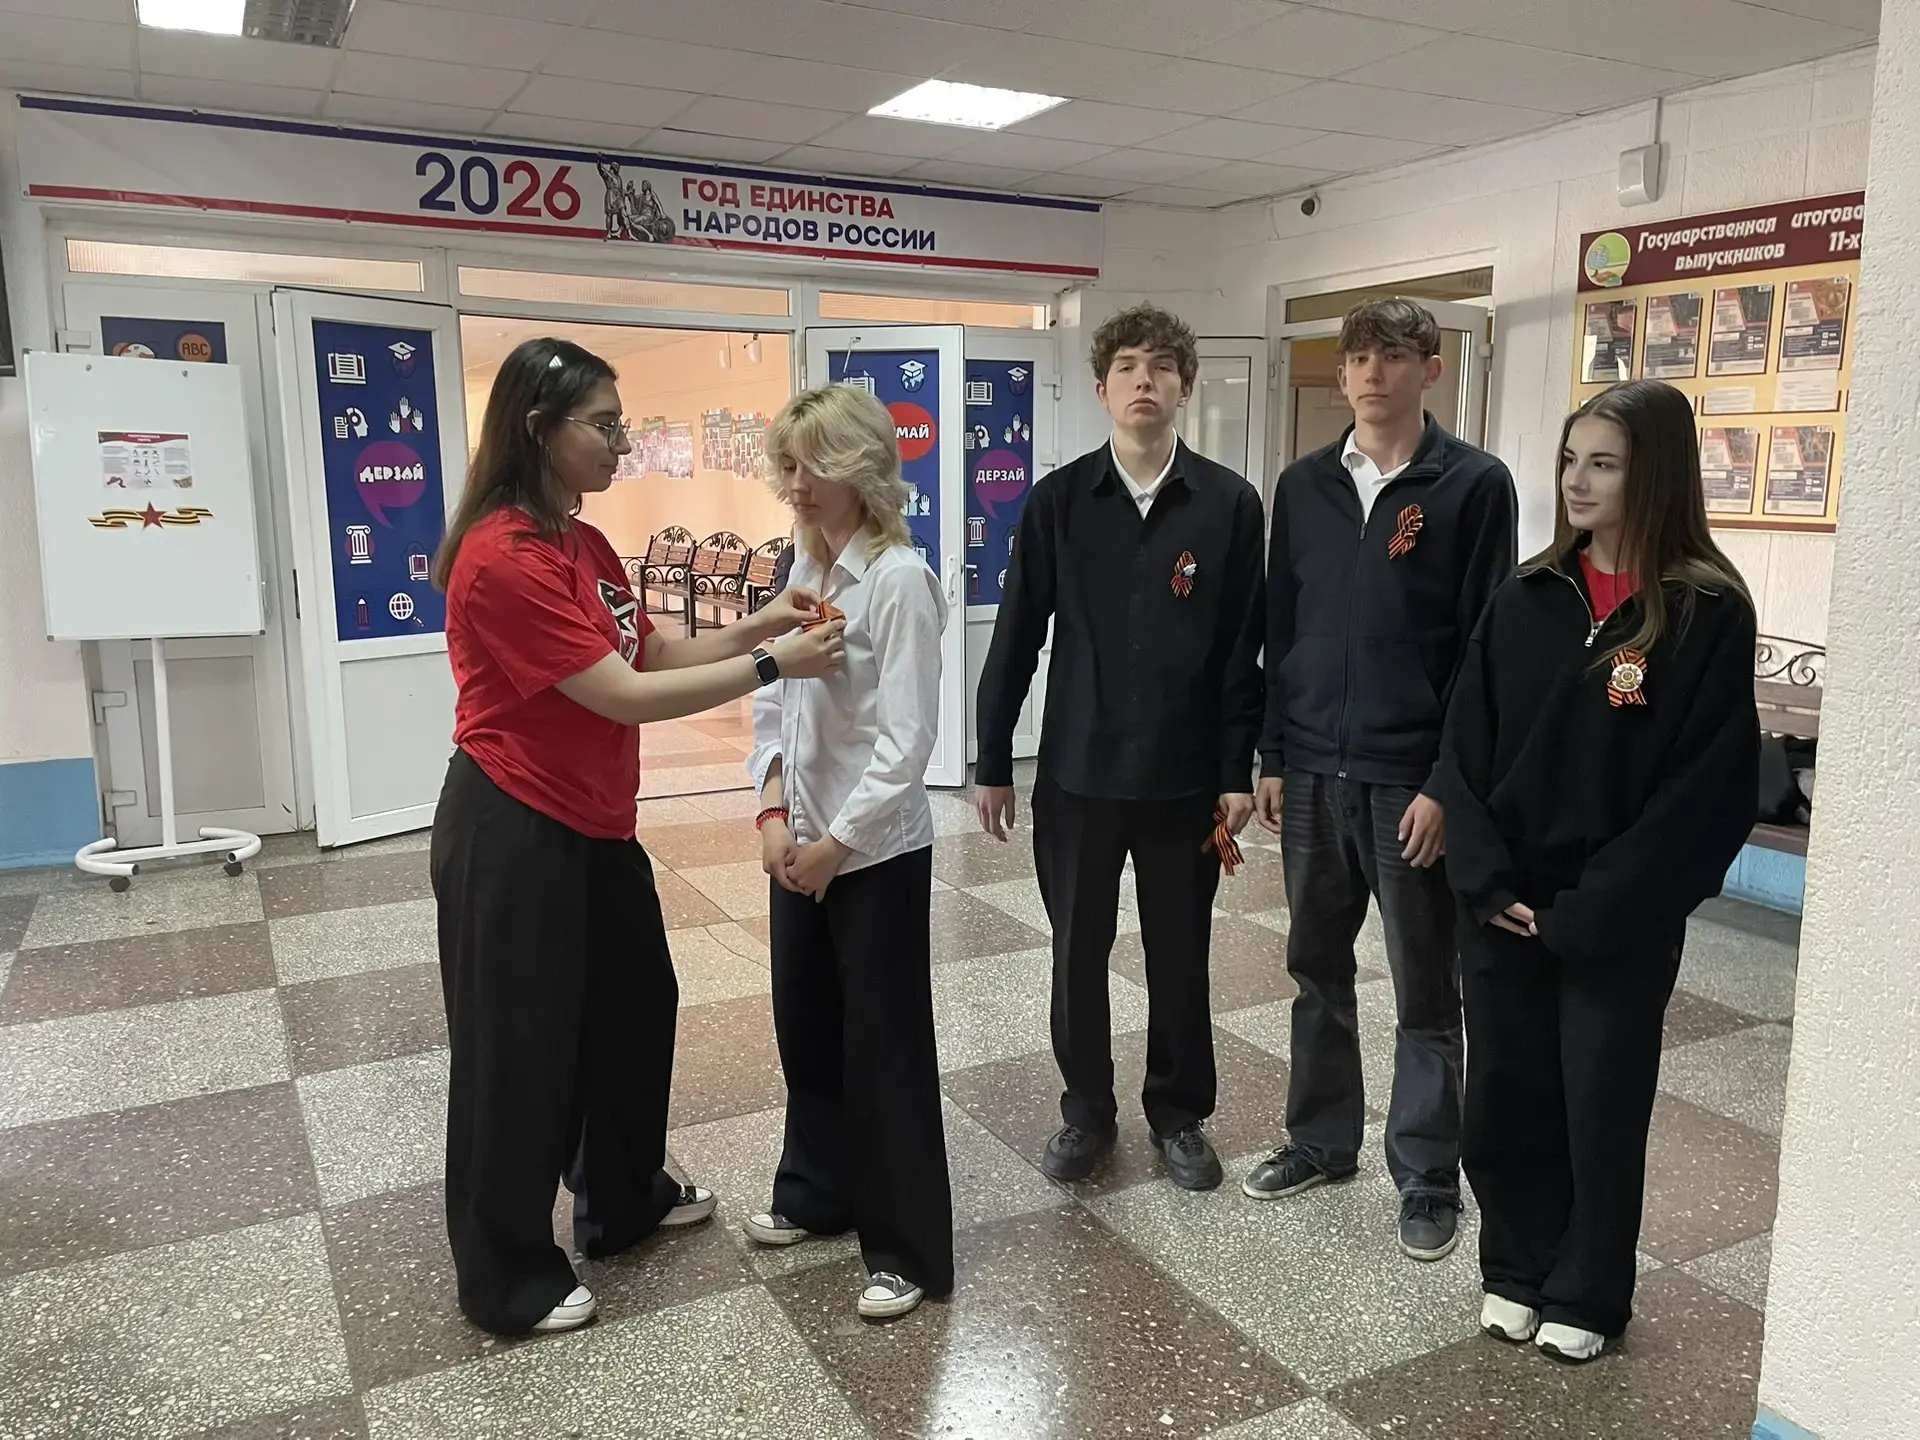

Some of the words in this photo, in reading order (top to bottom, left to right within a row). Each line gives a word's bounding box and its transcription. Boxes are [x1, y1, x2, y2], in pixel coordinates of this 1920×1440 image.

[416, 152, 581, 221] 2026
[681, 177, 740, 209] ГОД
[750, 185, 895, 219] ЕДИНСТВА
[683, 208, 819, 242] НАРОДОВ
[828, 222, 935, 251] РОССИИ
[1638, 216, 1777, 253] Государственная
[1791, 204, 1865, 228] итогова
[1674, 243, 1785, 271] выпускников
[1828, 231, 1861, 252] 11-х
[182, 342, 208, 356] ABC
[895, 423, 929, 439] МАЙ
[359, 462, 424, 483] ДЕРЗАЙ
[975, 467, 1025, 484] ДЕРЗАЙ
